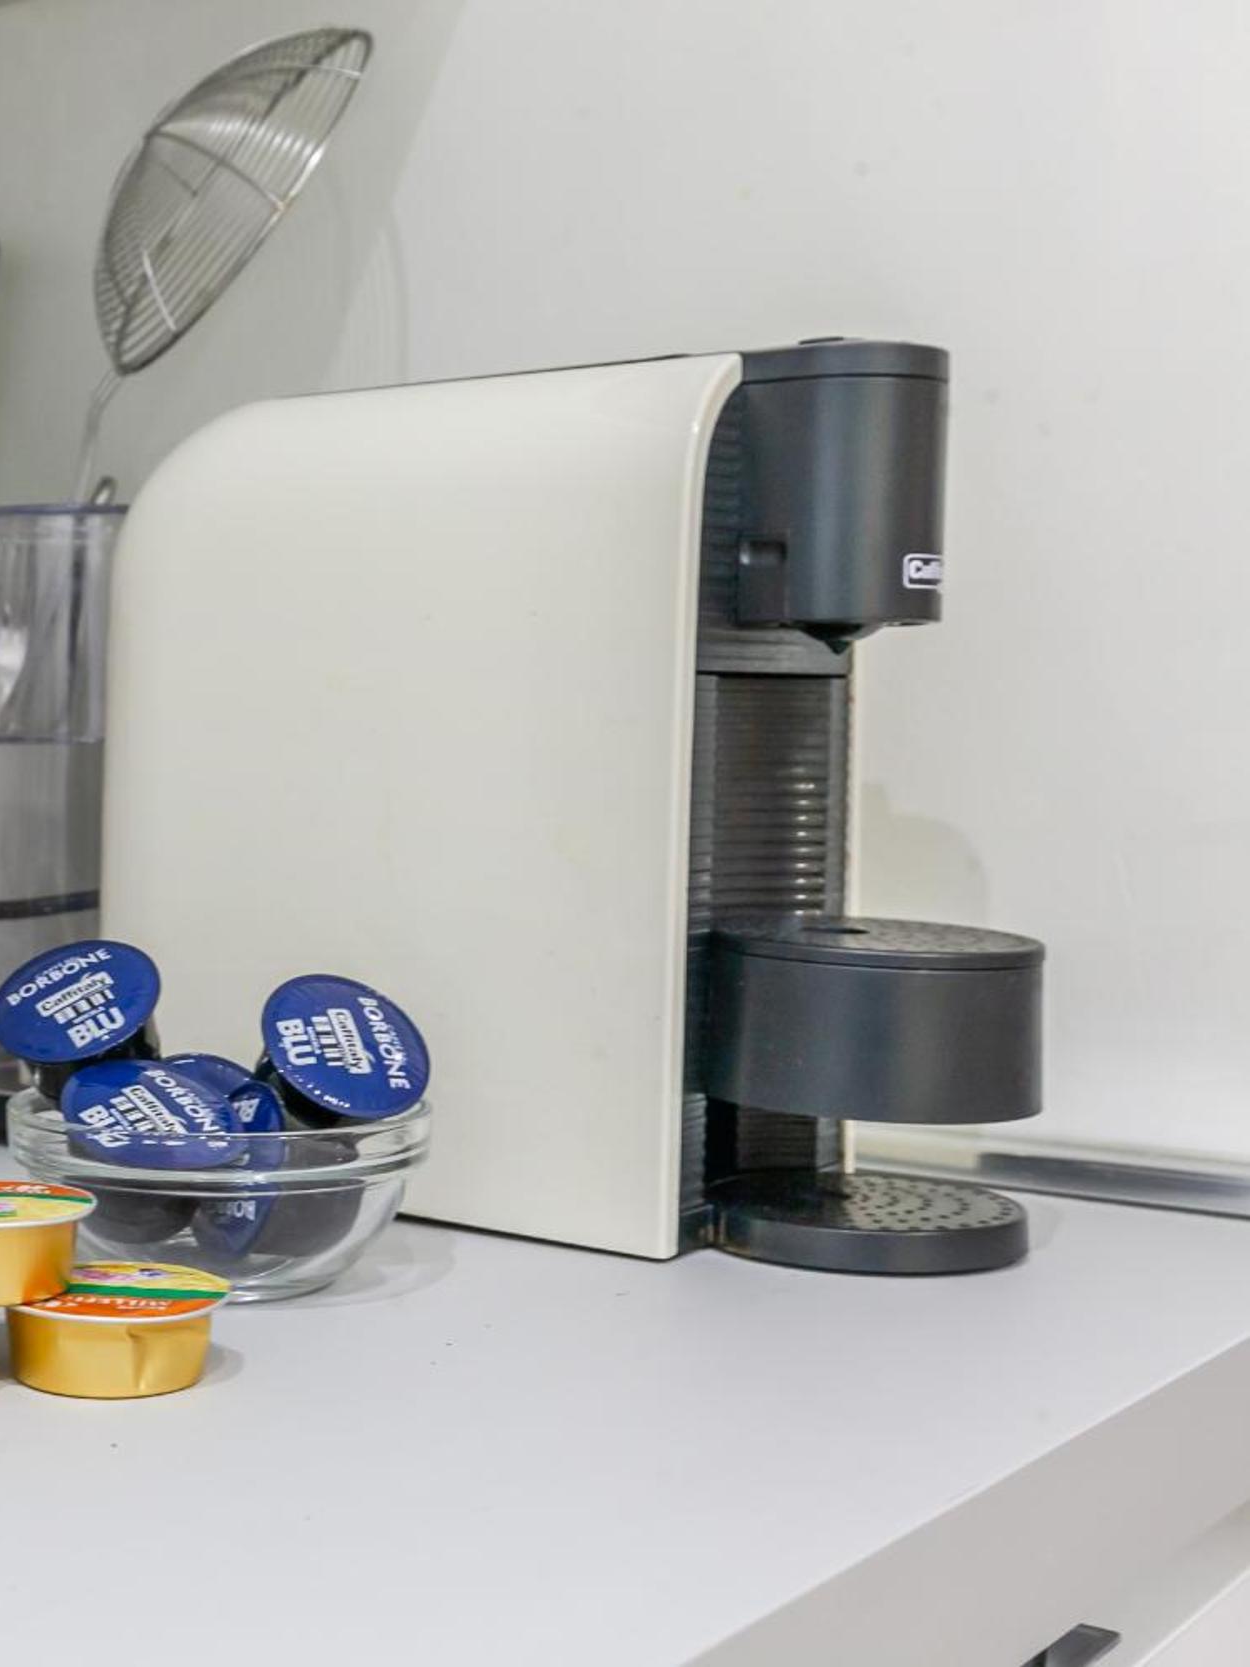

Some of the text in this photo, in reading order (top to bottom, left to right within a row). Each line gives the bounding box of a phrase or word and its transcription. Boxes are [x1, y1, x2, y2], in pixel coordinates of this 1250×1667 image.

[6, 948, 113, 1006] BORBONE
[67, 1006, 126, 1049] BLU
[276, 1018, 317, 1066] BLU
[357, 997, 412, 1090] BORBONE
